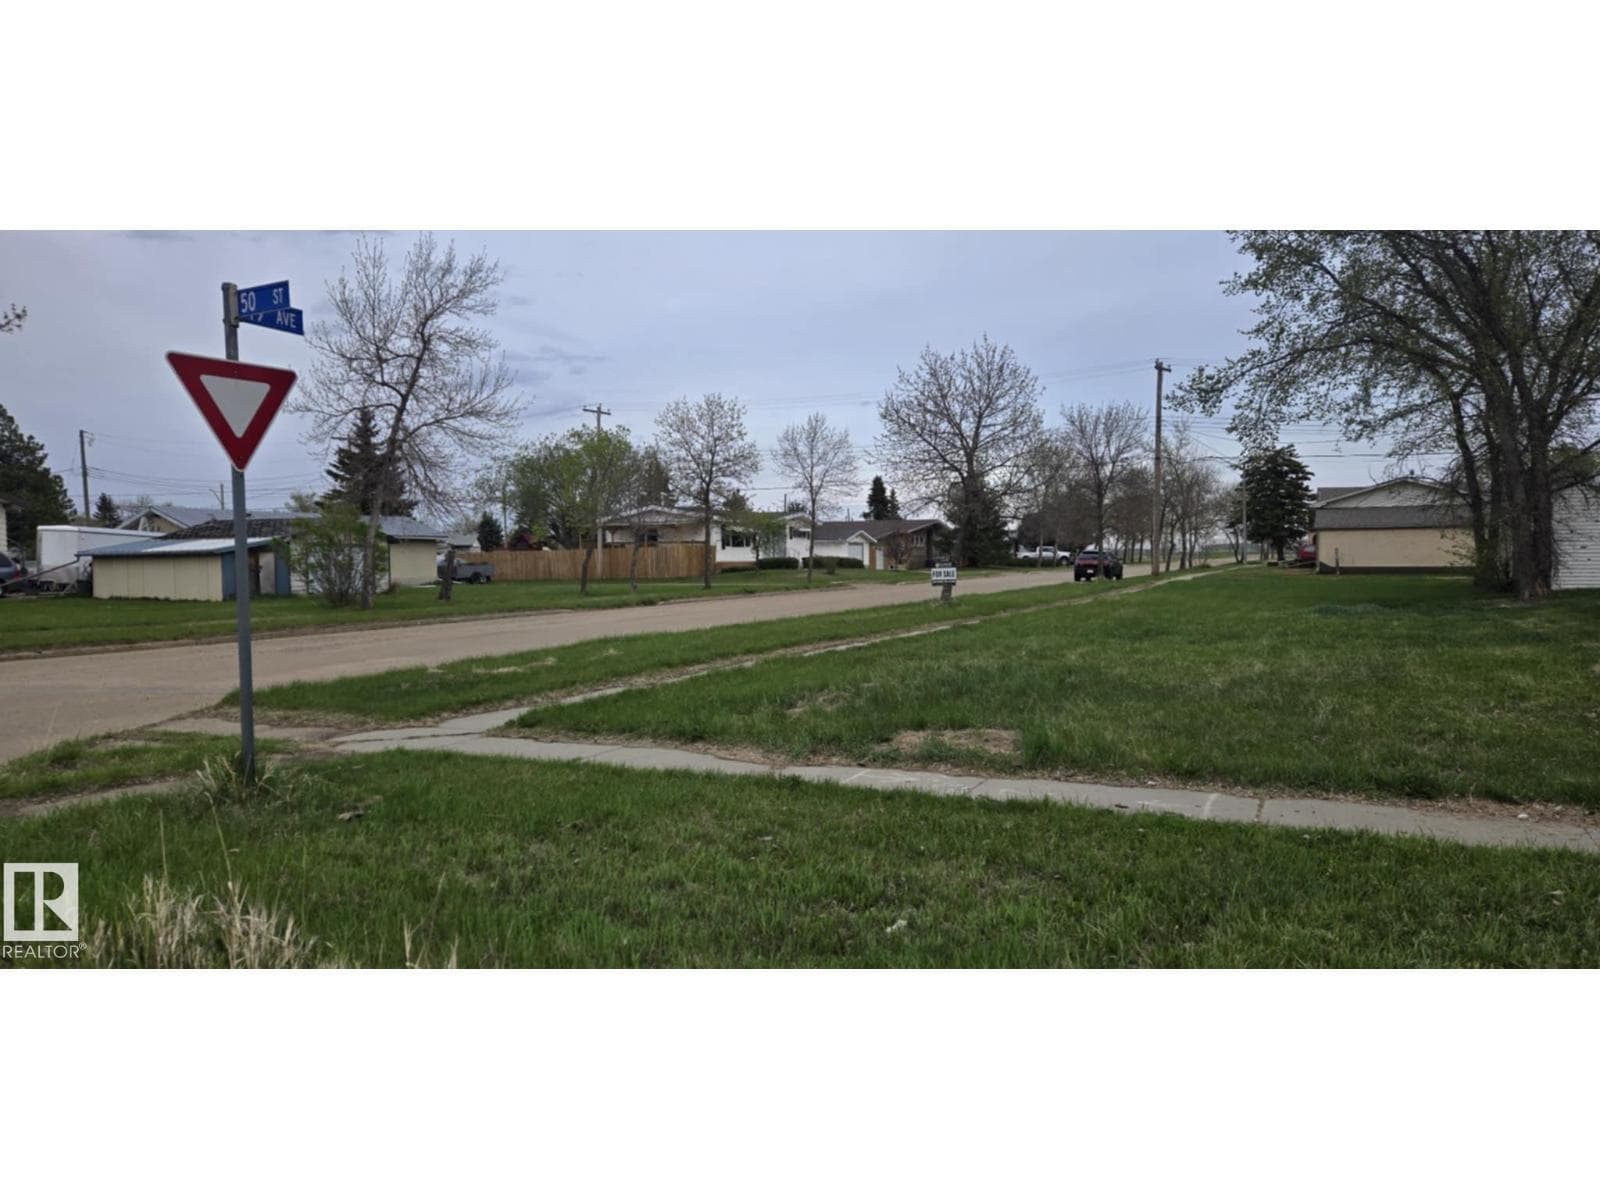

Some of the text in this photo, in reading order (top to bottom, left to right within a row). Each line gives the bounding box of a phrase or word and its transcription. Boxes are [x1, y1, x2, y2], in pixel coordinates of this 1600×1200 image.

[240, 288, 284, 313] 50 ST
[276, 309, 297, 329] AVE
[932, 570, 955, 578] FOR SALE
